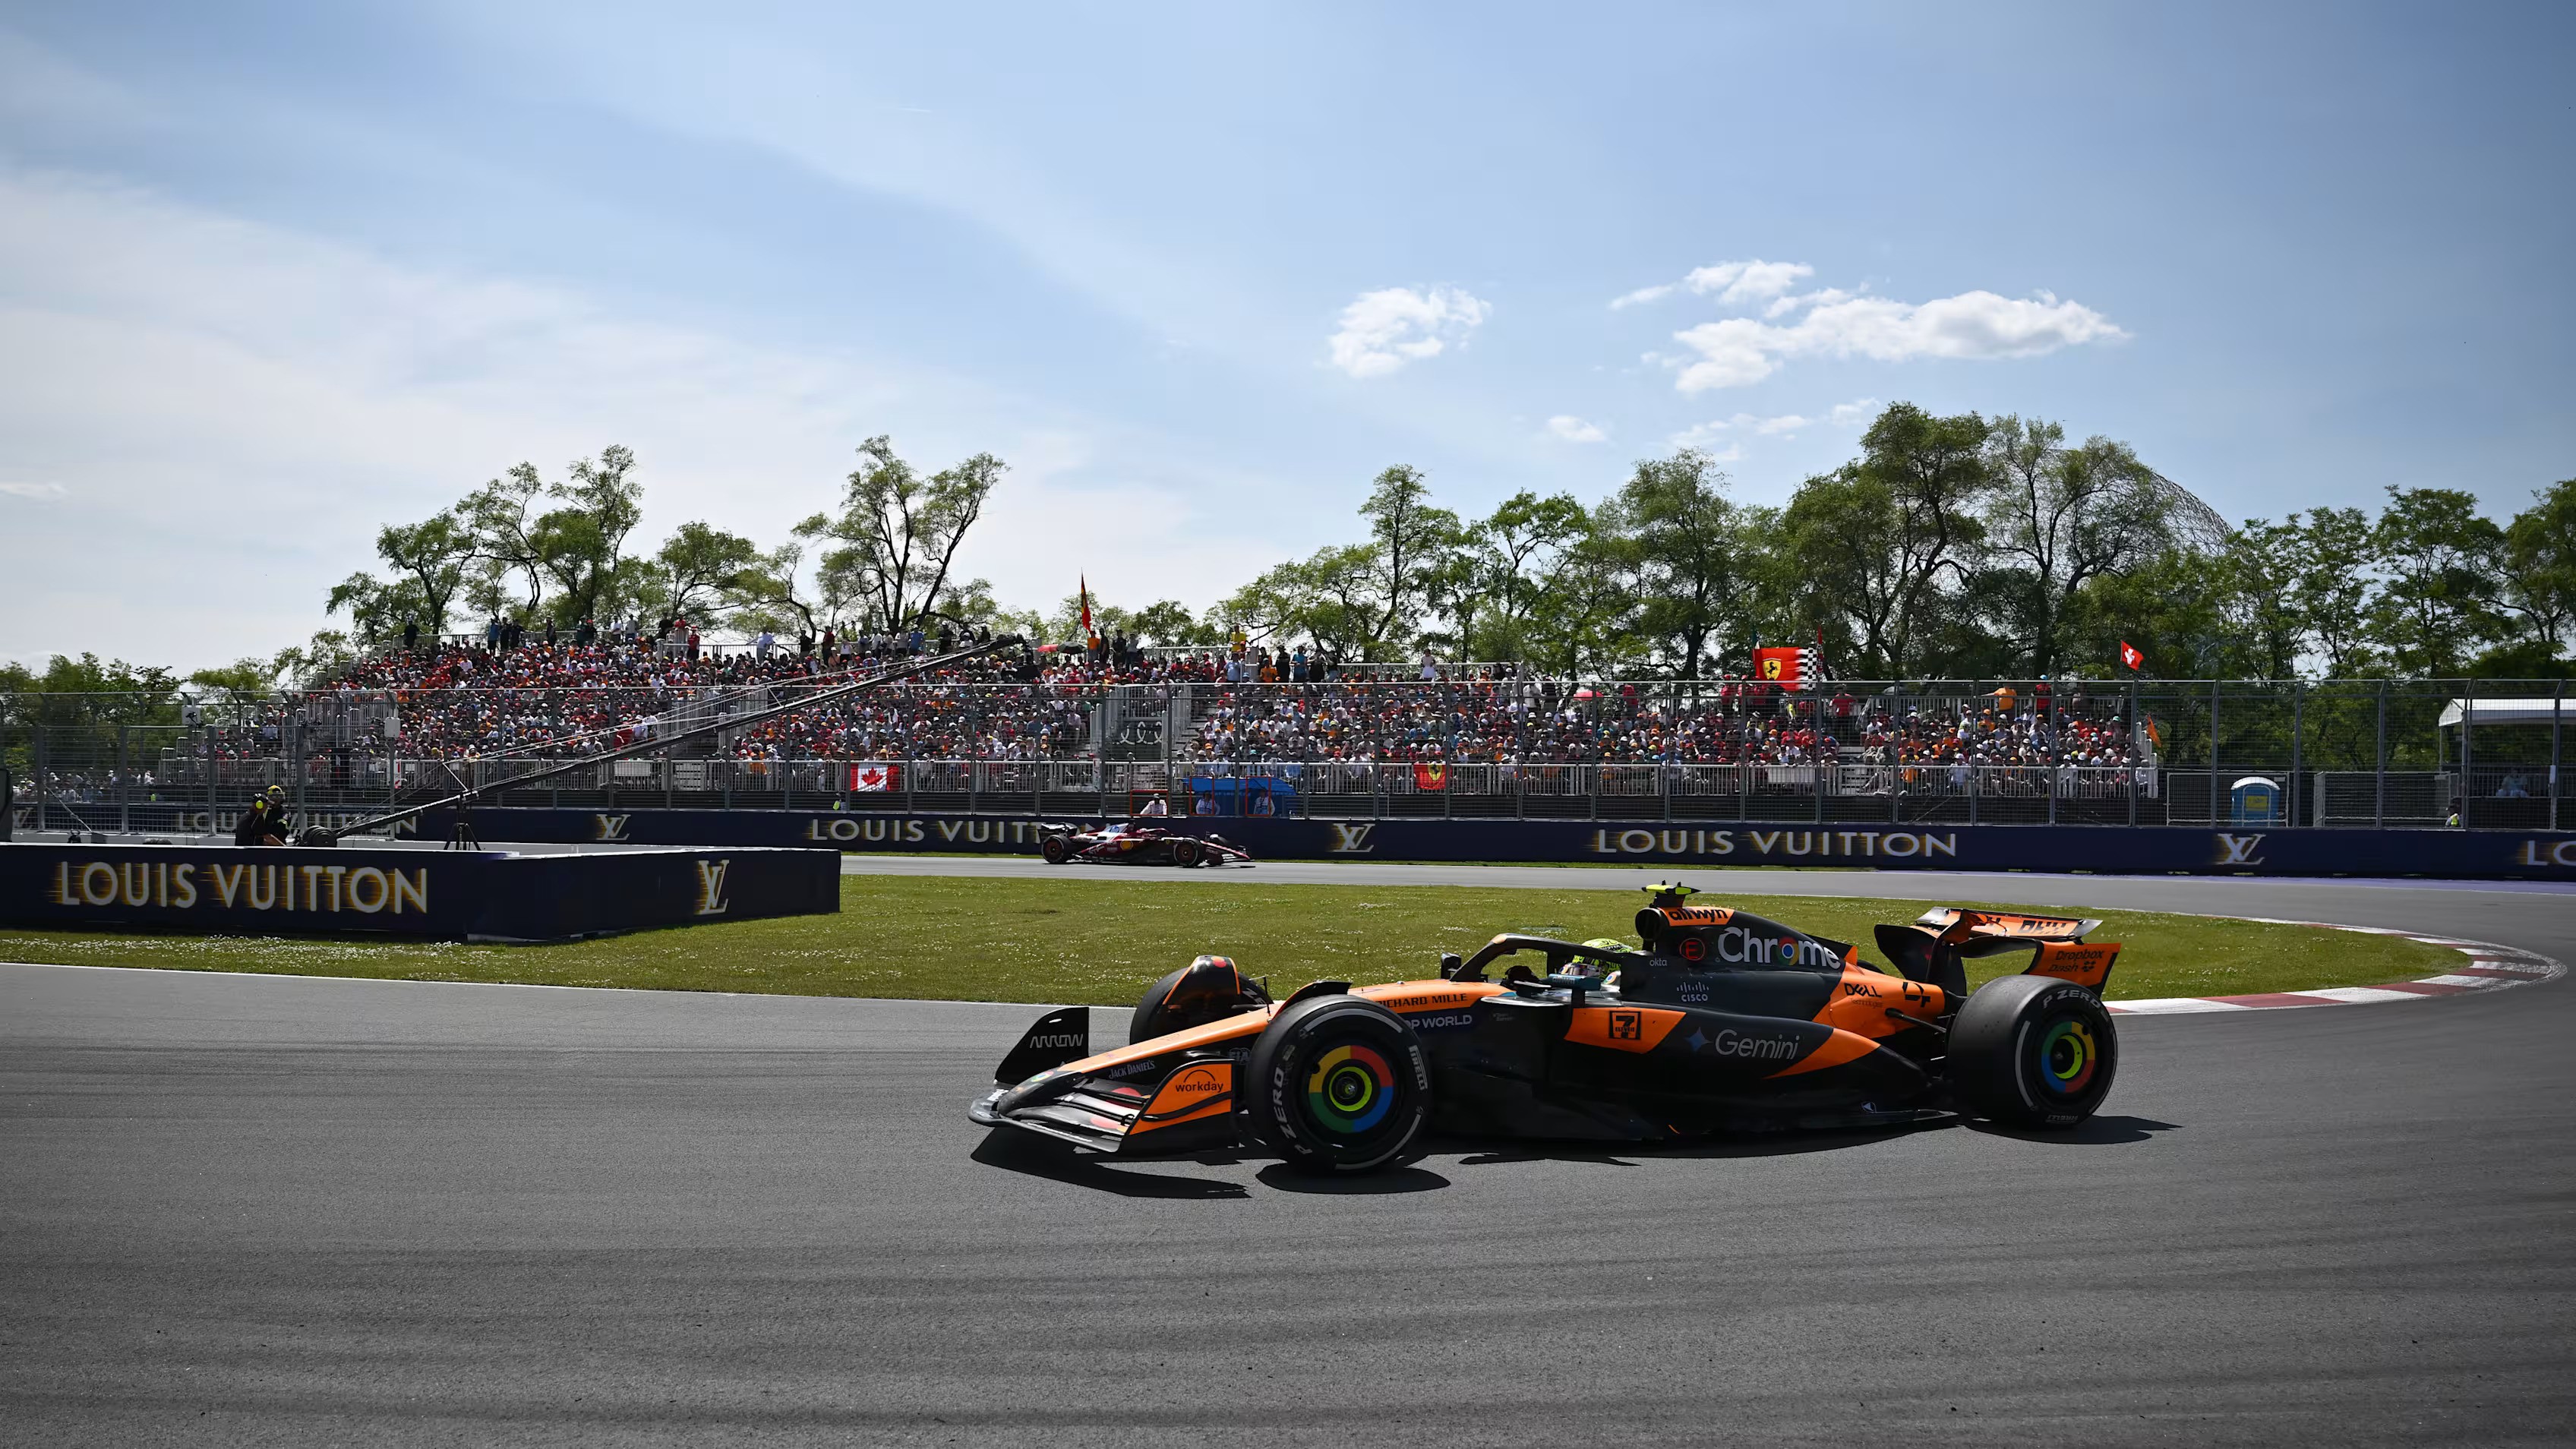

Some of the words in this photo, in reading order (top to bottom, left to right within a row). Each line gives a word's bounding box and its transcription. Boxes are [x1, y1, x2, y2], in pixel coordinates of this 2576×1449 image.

[812, 819, 925, 842] LOUIS
[1598, 829, 1735, 855] LOUIS
[1750, 831, 1956, 857] VUITTON
[61, 861, 197, 908] LOUIS
[213, 863, 427, 914] VUITTON
[1668, 908, 1728, 923] allwyn
[1717, 927, 1841, 970] Chrome
[2056, 949, 2105, 961] Dropbox
[1649, 958, 1668, 967] okta
[2048, 962, 2079, 972] Dash
[1432, 993, 1467, 1003] MILLE
[1844, 983, 1883, 998] DELL
[2042, 995, 2053, 1009] P
[2057, 990, 2101, 1009] ZERO
[1422, 1015, 1473, 1028] WORLD
[1029, 1034, 1084, 1049] ARROW
[1715, 1029, 1800, 1060] Gemini
[1109, 1067, 1127, 1080] JACK
[1127, 1060, 1156, 1075] DANIEL'S
[1175, 1081, 1224, 1093] workday
[1273, 1066, 1297, 1139] ZERO
[1294, 1144, 1313, 1155] P
